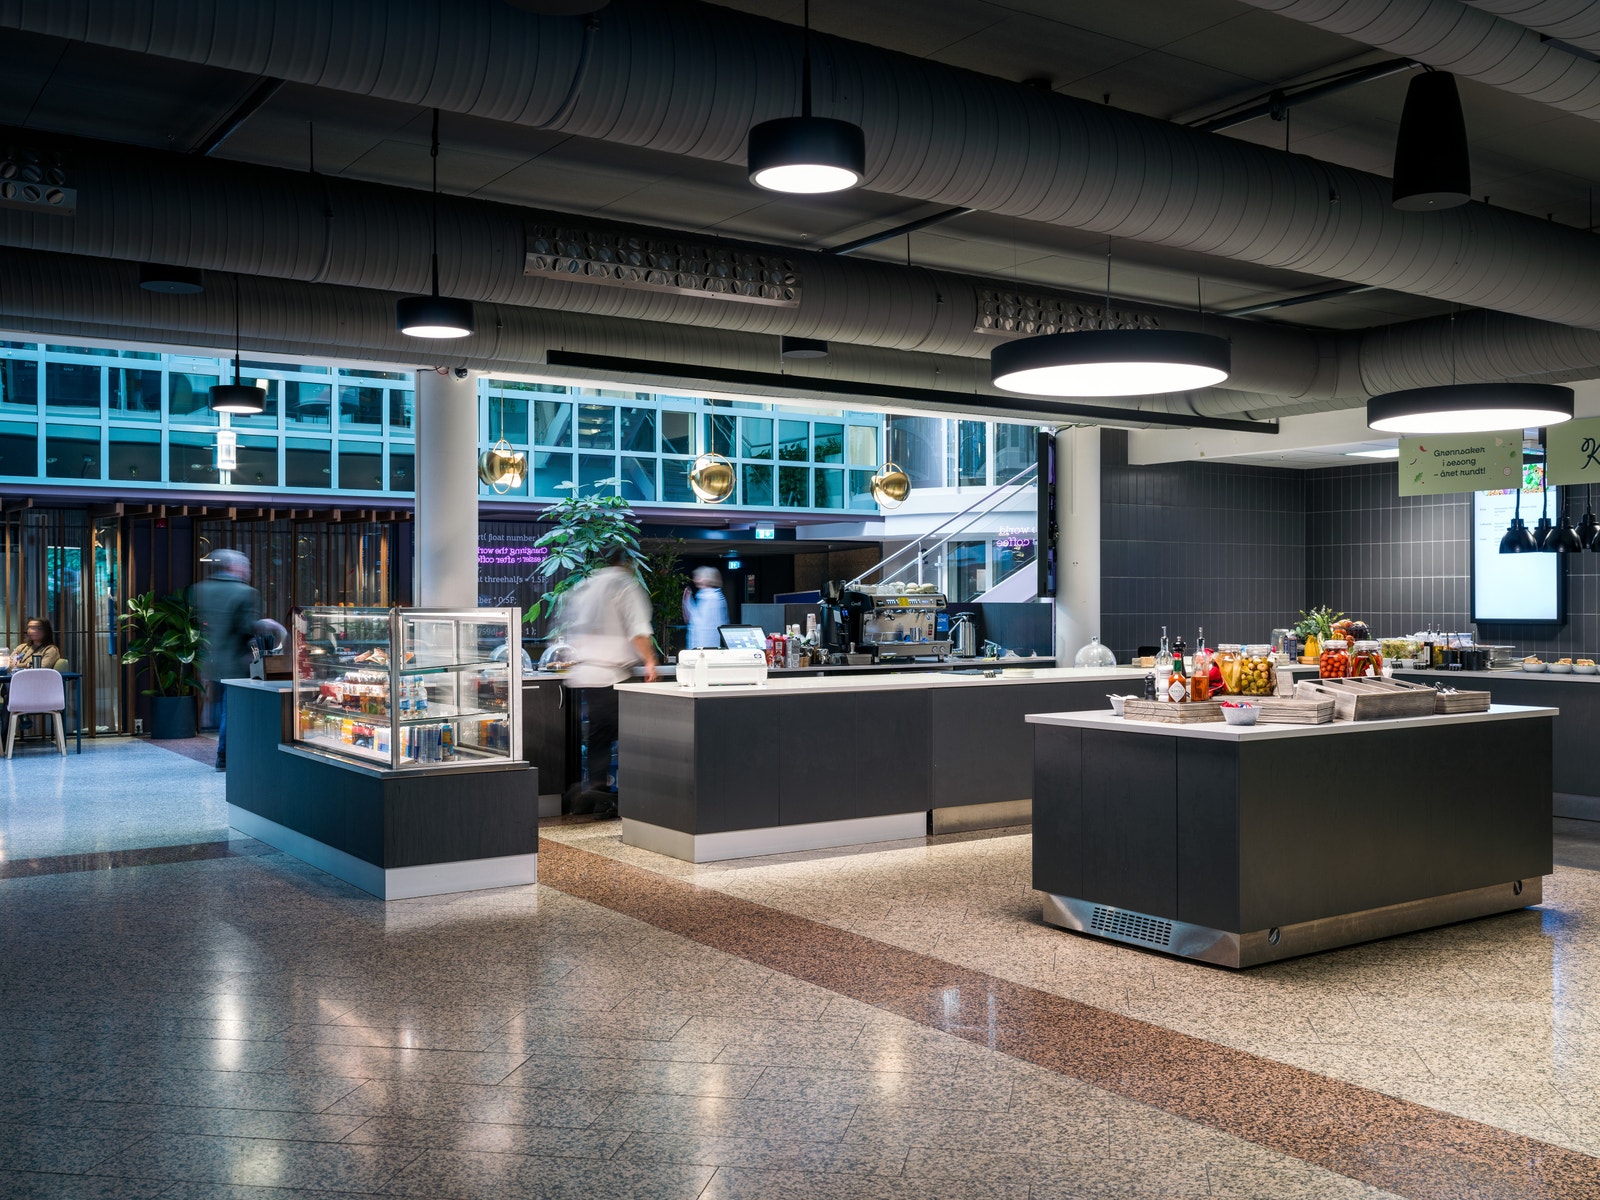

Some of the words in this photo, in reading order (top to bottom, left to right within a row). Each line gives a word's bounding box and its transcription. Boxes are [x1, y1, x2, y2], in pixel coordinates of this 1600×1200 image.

[1433, 446, 1485, 457] Grønnsaker
[1446, 458, 1477, 467] sesong
[1440, 470, 1459, 478] året
[1459, 467, 1486, 476] rundt!
[506, 534, 536, 542] number
